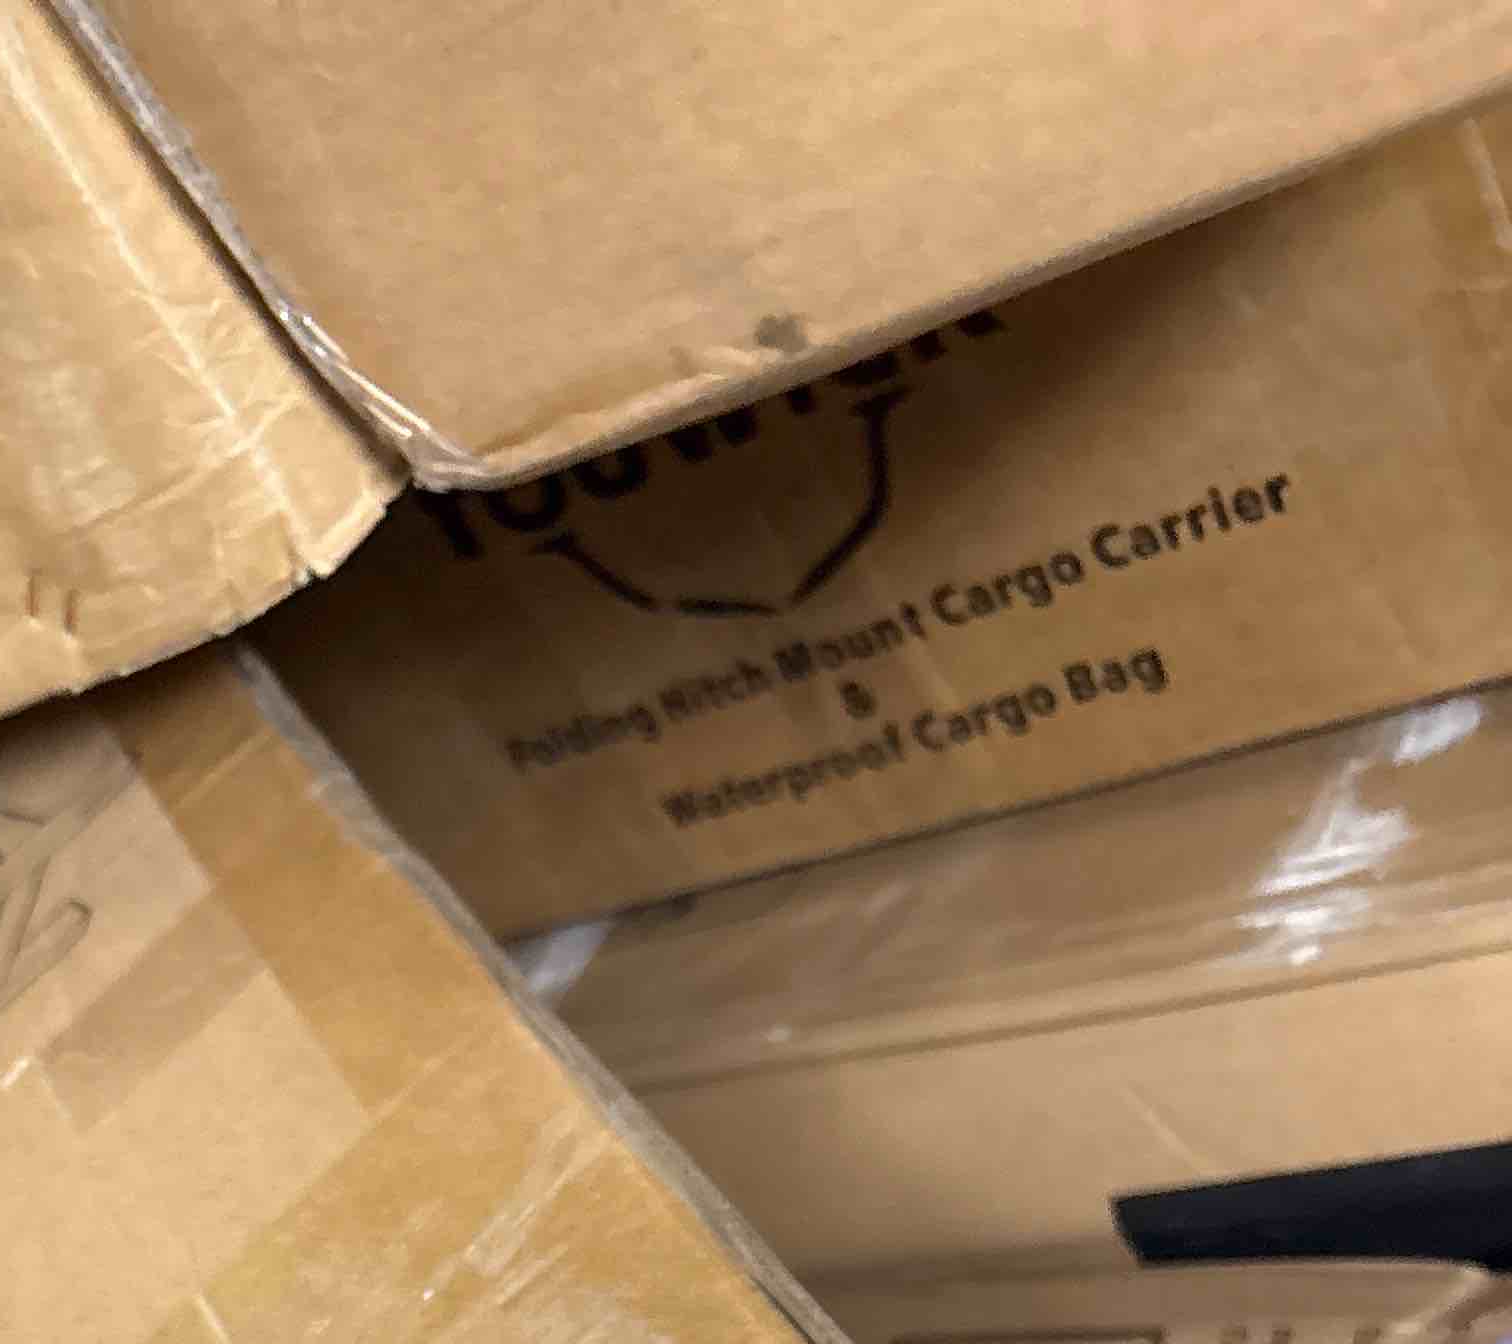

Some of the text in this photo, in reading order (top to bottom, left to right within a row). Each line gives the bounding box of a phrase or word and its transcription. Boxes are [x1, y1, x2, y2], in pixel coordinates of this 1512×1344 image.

[773, 601, 927, 681] Mount
[929, 550, 1086, 627] Cargo
[1090, 471, 1291, 570] Carrier
[660, 646, 1170, 828] Waterproof Cargo Bag
